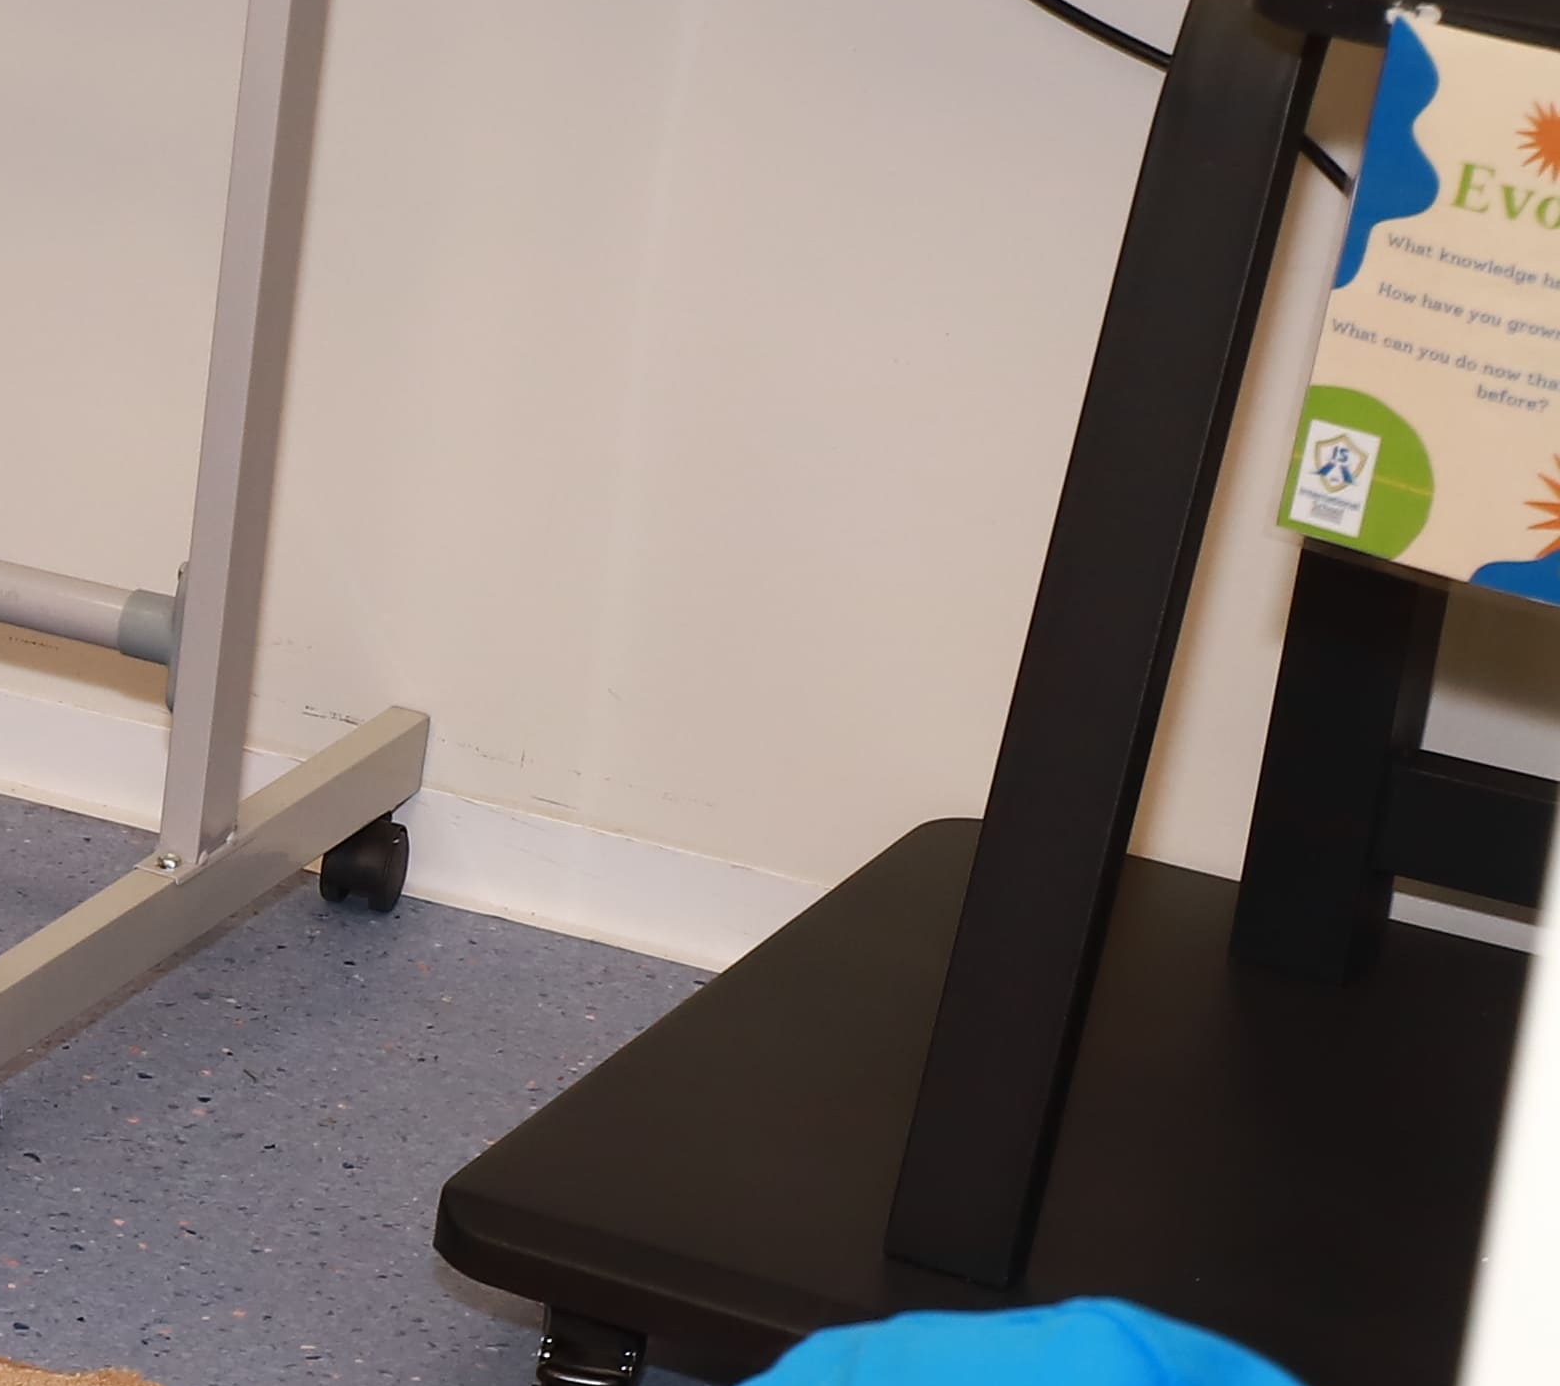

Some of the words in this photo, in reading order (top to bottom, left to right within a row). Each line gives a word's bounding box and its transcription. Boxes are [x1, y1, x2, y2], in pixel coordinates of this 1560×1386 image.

[1387, 230, 1434, 259] What
[1439, 247, 1538, 285] knowledge
[1377, 281, 1417, 304] How
[1422, 293, 1464, 317] have
[1466, 309, 1501, 329] you
[1331, 317, 1378, 344] What
[1383, 335, 1414, 355] can
[1416, 346, 1451, 365] you
[1455, 356, 1478, 371] do
[1482, 364, 1521, 383] now
[1476, 384, 1550, 412] before?
